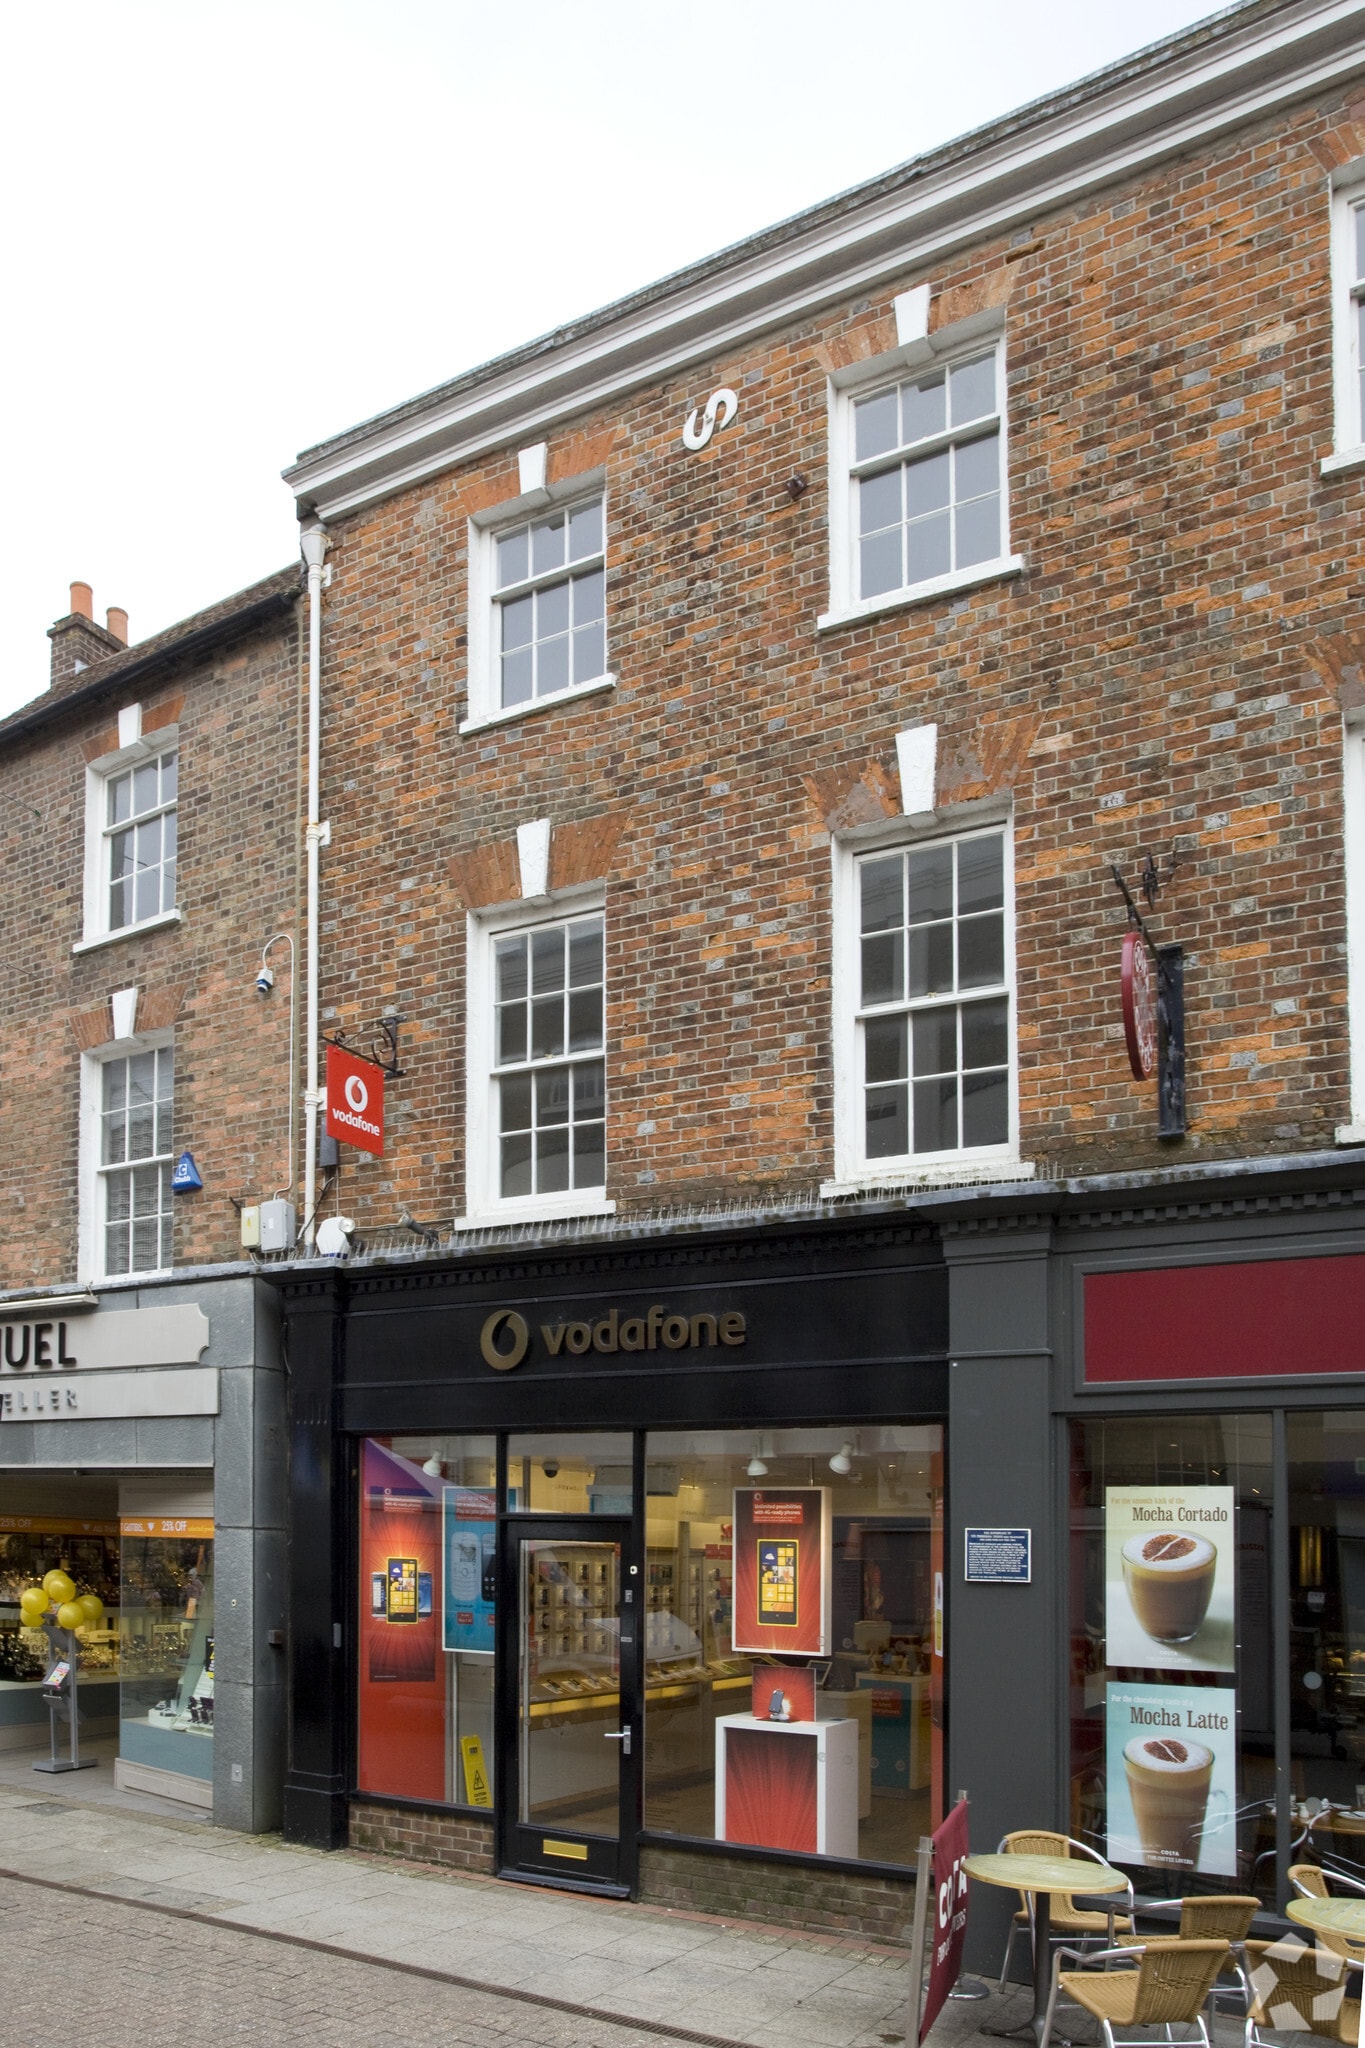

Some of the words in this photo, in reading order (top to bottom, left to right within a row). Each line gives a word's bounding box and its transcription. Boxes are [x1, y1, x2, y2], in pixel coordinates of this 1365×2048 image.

[332, 1108, 380, 1136] vodafone
[540, 1304, 746, 1355] vodafone
[0, 1322, 77, 1368] UEL
[1132, 1507, 1173, 1522] Mocha
[1178, 1507, 1228, 1522] Cortado
[1130, 1706, 1181, 1727] Mocha
[1187, 1710, 1228, 1730] Latte
